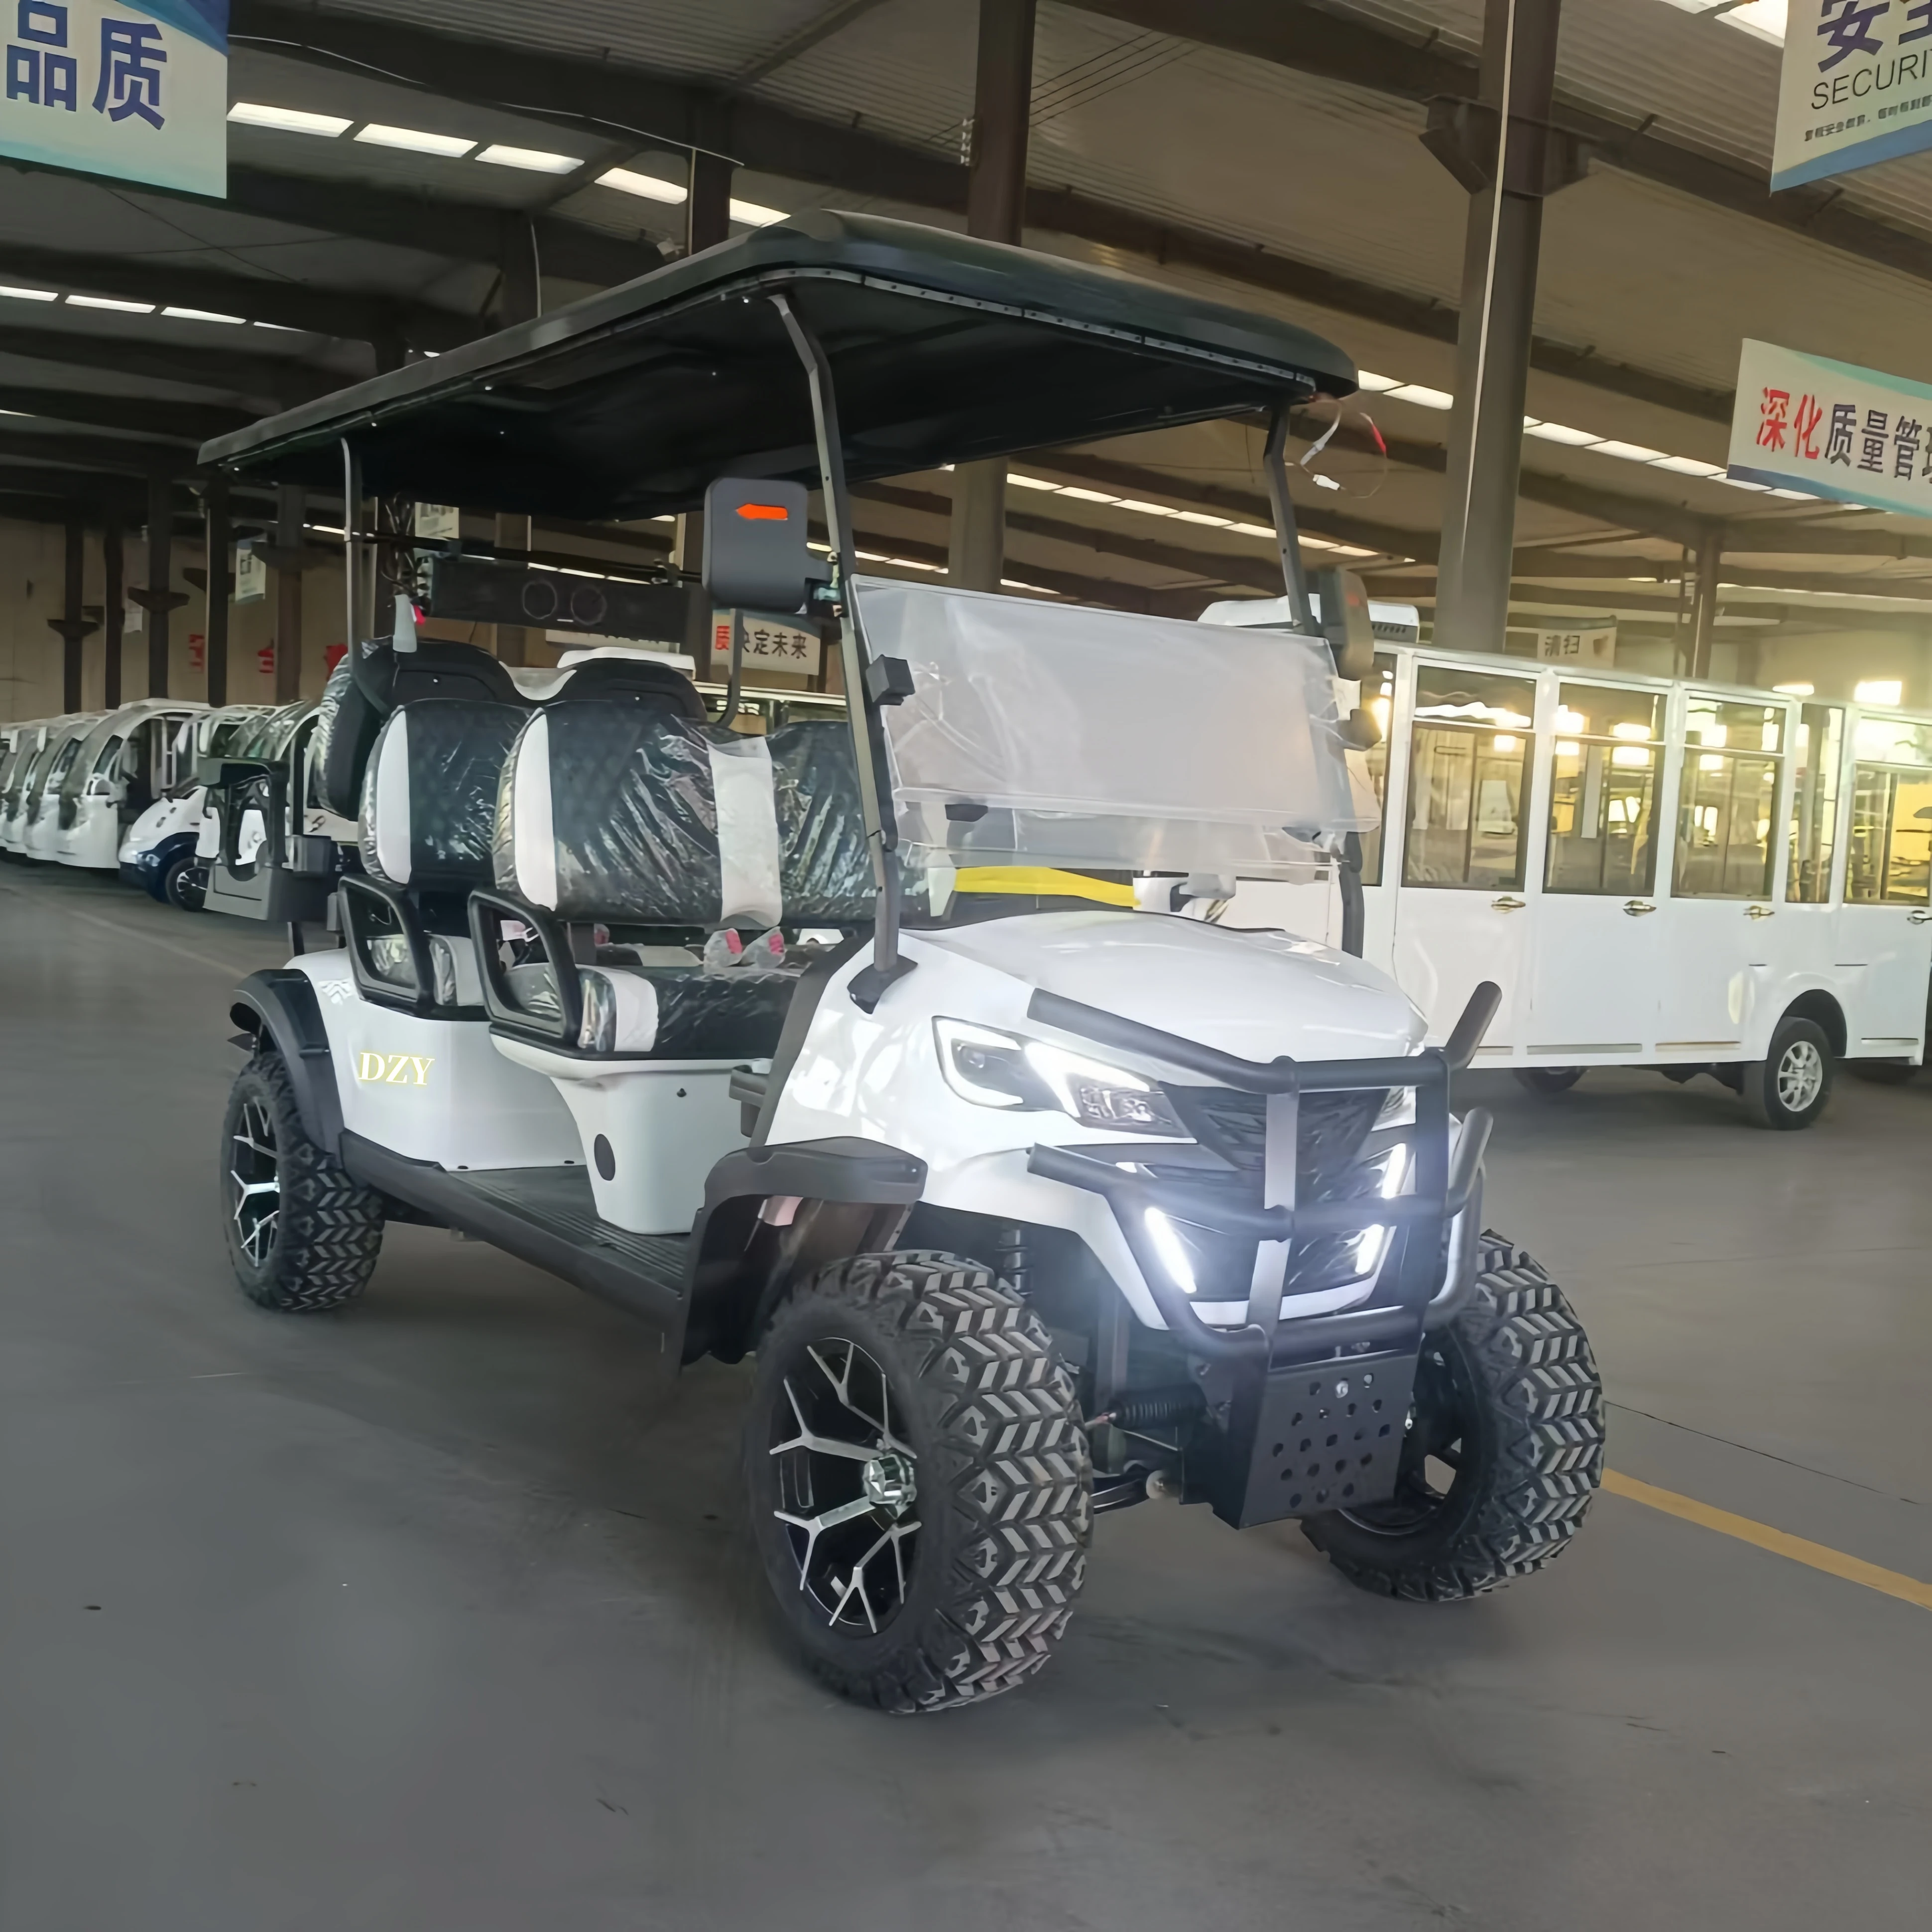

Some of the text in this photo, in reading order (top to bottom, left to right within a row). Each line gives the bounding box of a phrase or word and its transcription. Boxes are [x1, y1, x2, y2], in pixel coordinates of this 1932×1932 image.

[6, 0, 167, 130] 品质
[1811, 49, 1932, 110] SECURI
[358, 1052, 435, 1086] DZY
